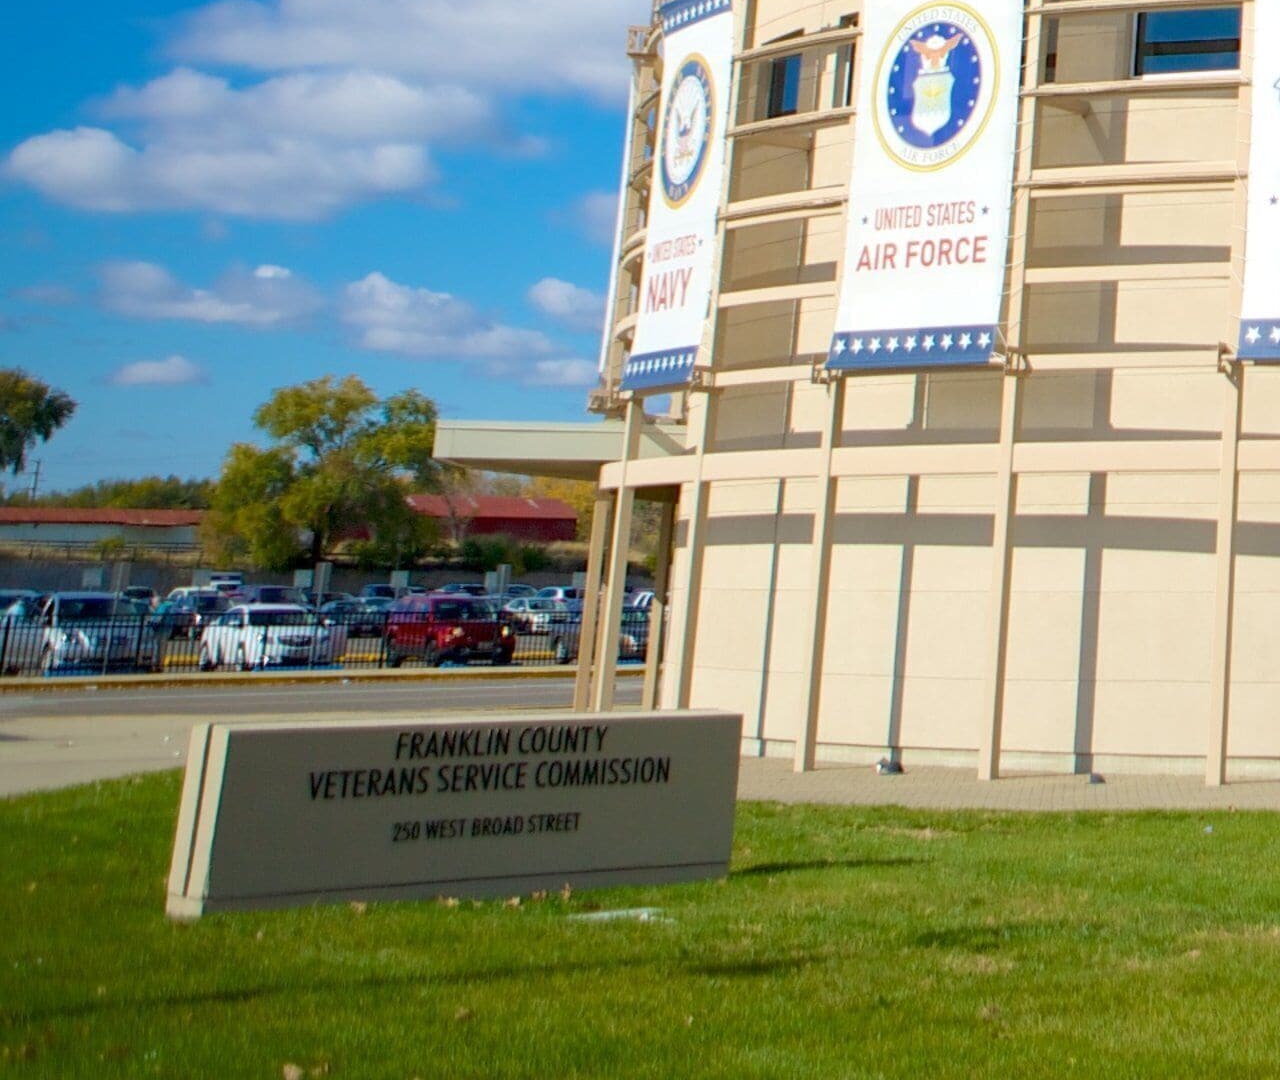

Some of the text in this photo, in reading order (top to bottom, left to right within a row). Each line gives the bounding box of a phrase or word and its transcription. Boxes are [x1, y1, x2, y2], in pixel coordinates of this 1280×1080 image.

[874, 200, 976, 232] UNITED STATES
[855, 235, 988, 272] AIR FORCE
[645, 266, 693, 315] NAVY
[394, 726, 609, 761] FRANKLIN COUNTY
[309, 756, 671, 801] VETERANS SERVICE COMMISSION
[392, 812, 581, 843] 250 WEST BROAD STREET
